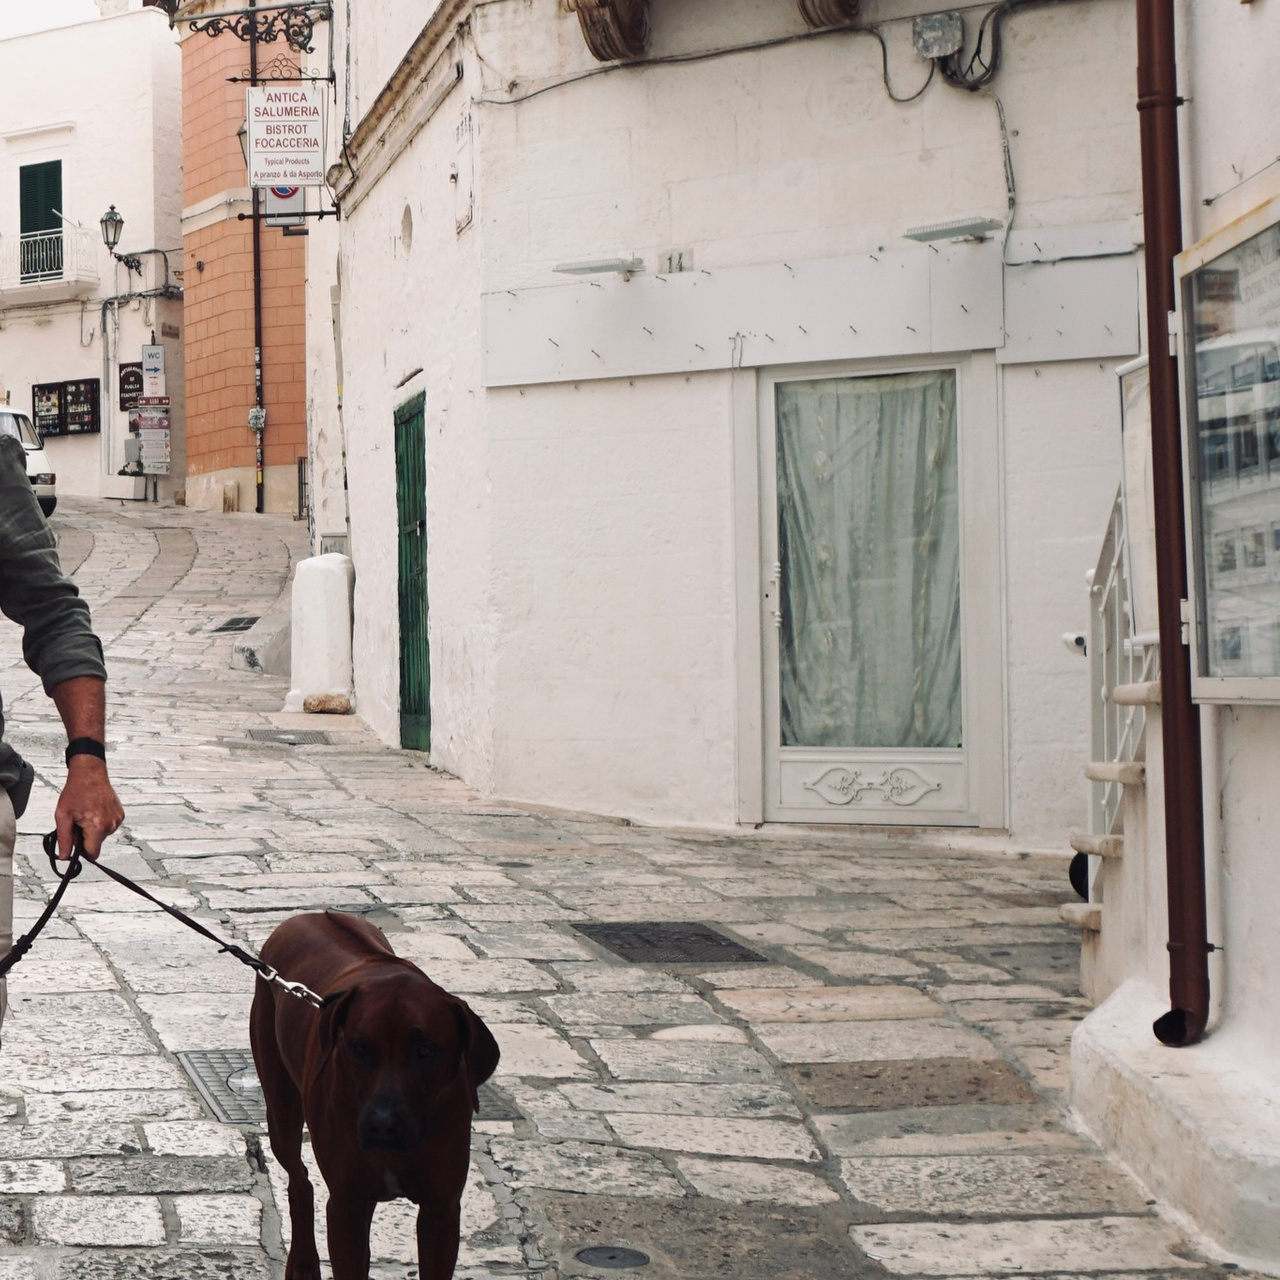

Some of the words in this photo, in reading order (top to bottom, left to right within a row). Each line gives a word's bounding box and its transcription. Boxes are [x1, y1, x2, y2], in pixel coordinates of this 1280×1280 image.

[266, 92, 308, 103] ANTICA
[254, 106, 320, 117] SALUMERIA
[265, 124, 308, 135] BISTROT
[255, 137, 319, 148] FOCACCERIA
[264, 157, 284, 166] Typical
[285, 157, 310, 165] Products
[260, 171, 281, 179] pranzo
[289, 170, 297, 178] da
[298, 170, 323, 180] Asporto
[667, 252, 685, 274] 14
